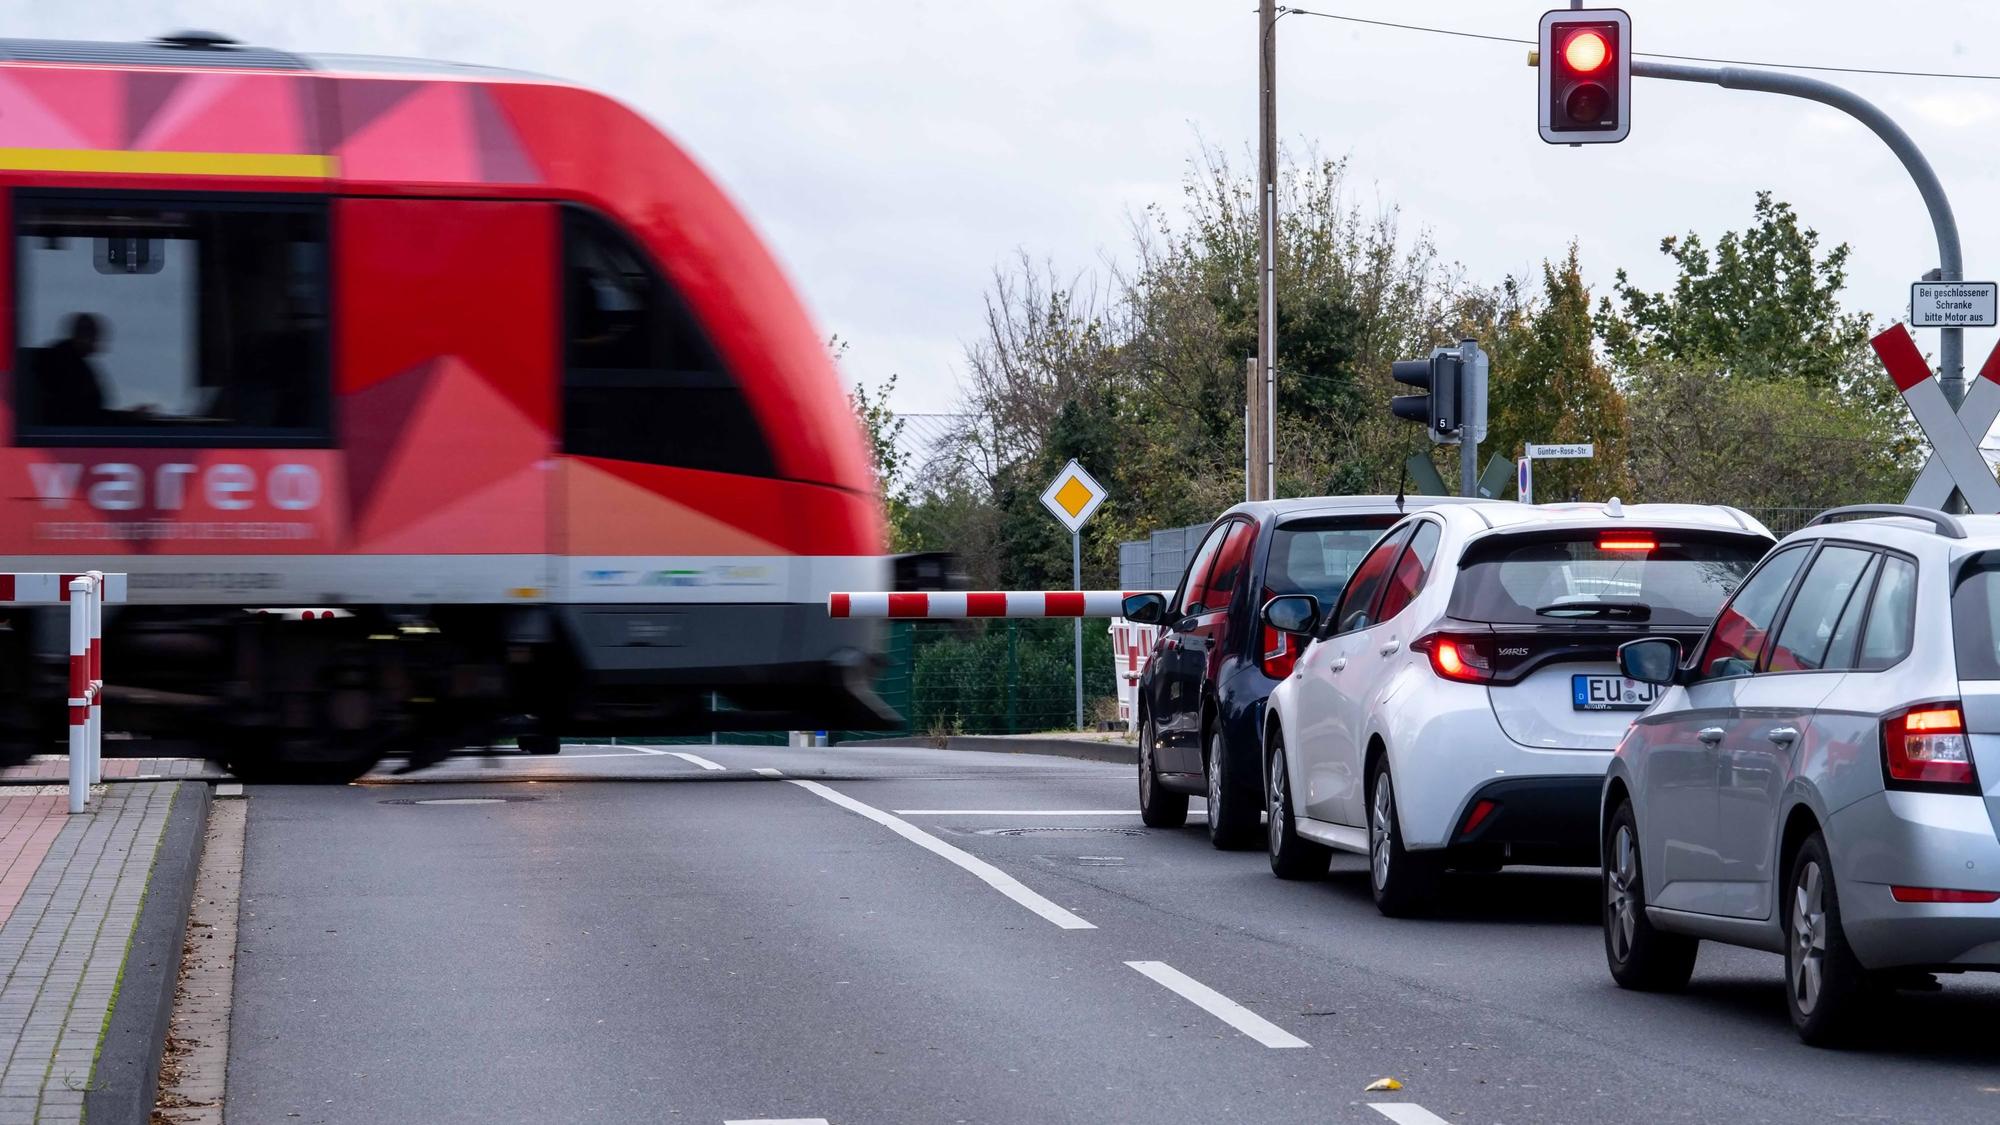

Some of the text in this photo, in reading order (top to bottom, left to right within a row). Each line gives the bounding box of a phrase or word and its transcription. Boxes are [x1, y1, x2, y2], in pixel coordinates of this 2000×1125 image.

[1920, 288, 1989, 299] Bei geschlossener
[1936, 300, 1972, 309] Schranke
[1925, 312, 1942, 321] bitte
[1945, 312, 1967, 321] Motor
[1440, 419, 1446, 428] 5
[27, 463, 321, 510] vareo
[1498, 647, 1529, 656] YARIS
[1590, 679, 1621, 702] EU
